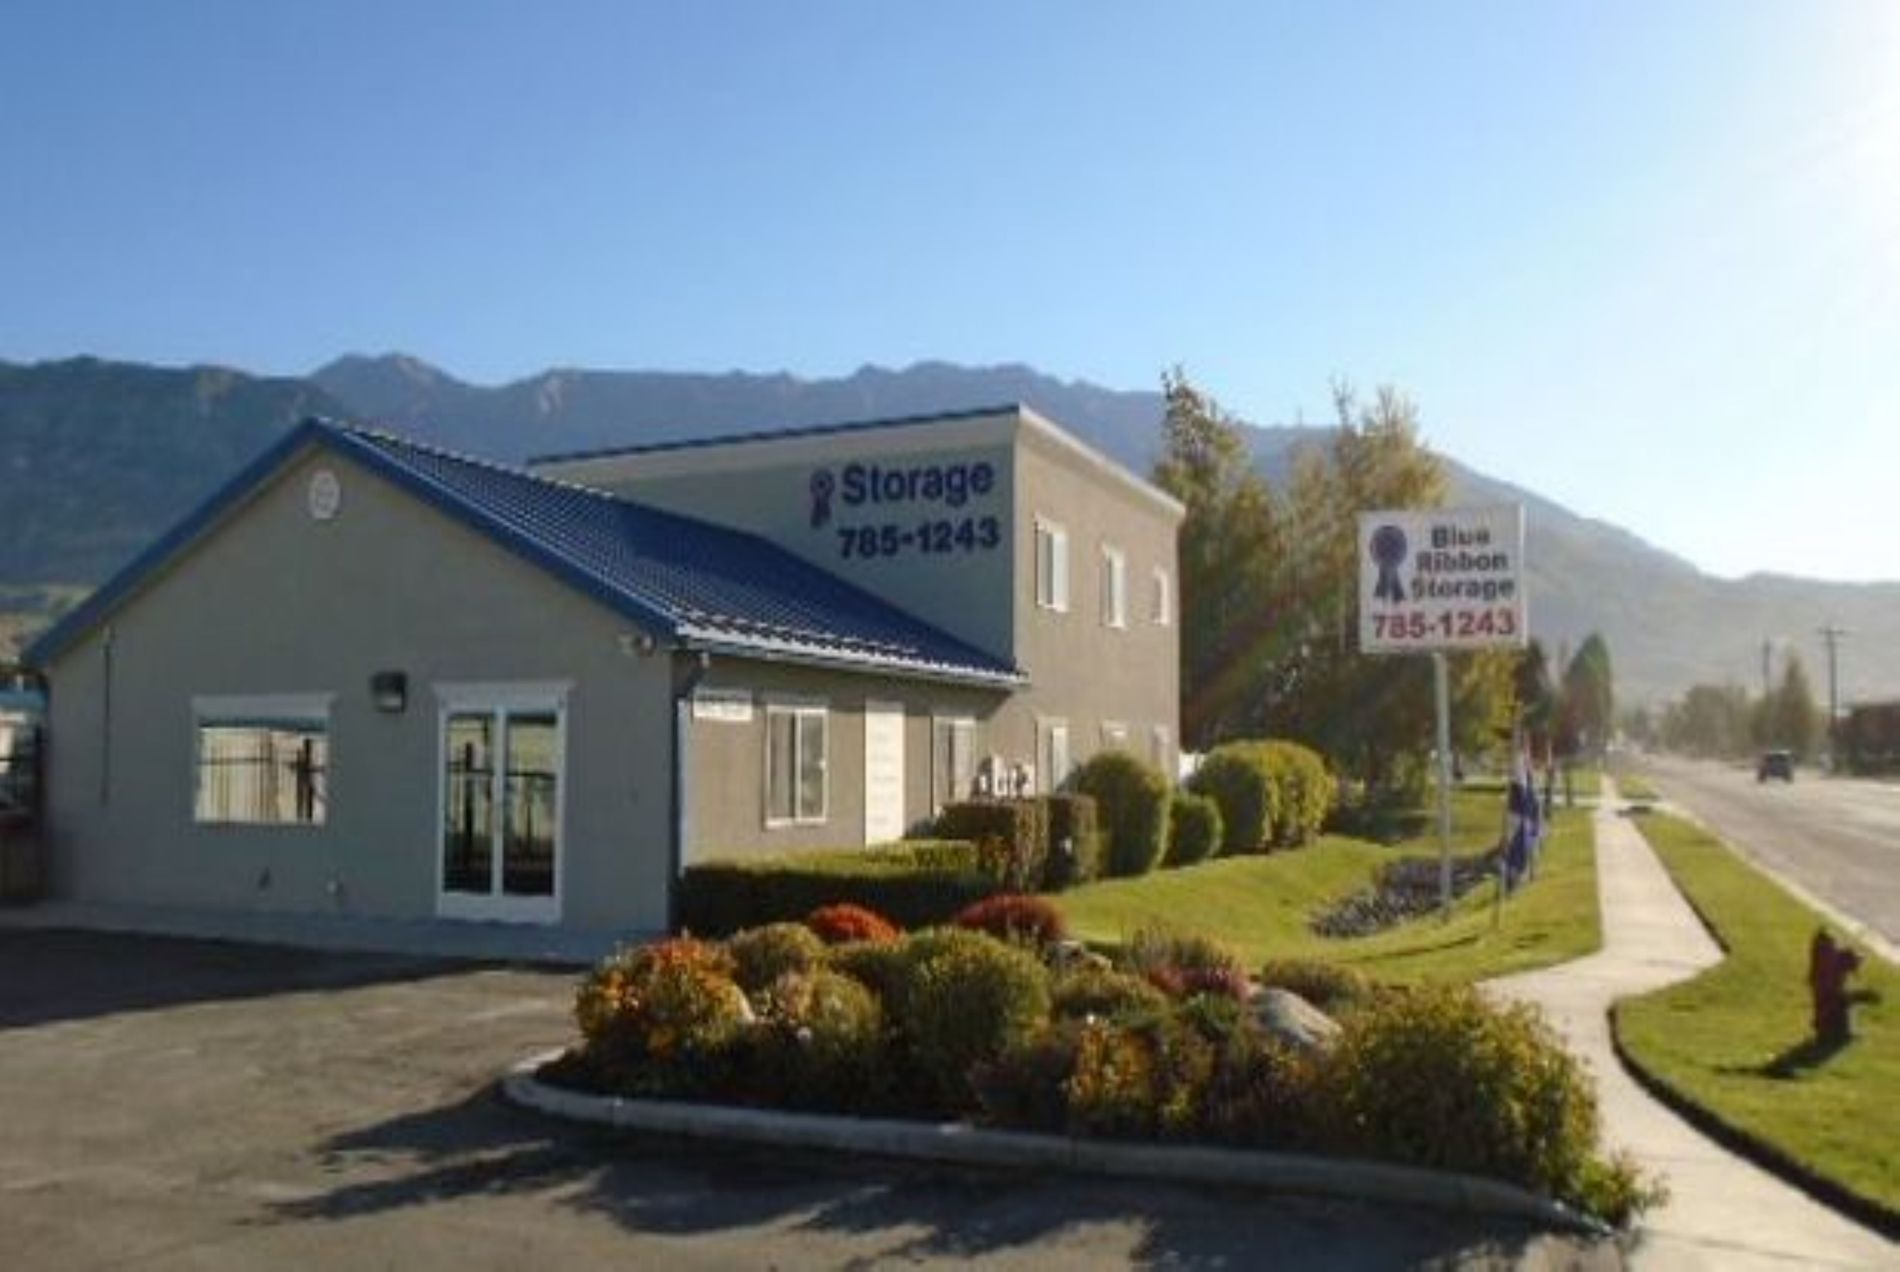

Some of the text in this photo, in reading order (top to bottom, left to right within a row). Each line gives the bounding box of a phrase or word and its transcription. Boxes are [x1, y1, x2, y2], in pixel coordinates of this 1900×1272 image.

[842, 462, 994, 507] Storage
[838, 517, 1000, 558] 785-1243
[1431, 525, 1491, 548] Blue
[1417, 551, 1508, 573] Ribbon
[1411, 578, 1515, 601] Storage
[1373, 608, 1515, 639] 785-1243
